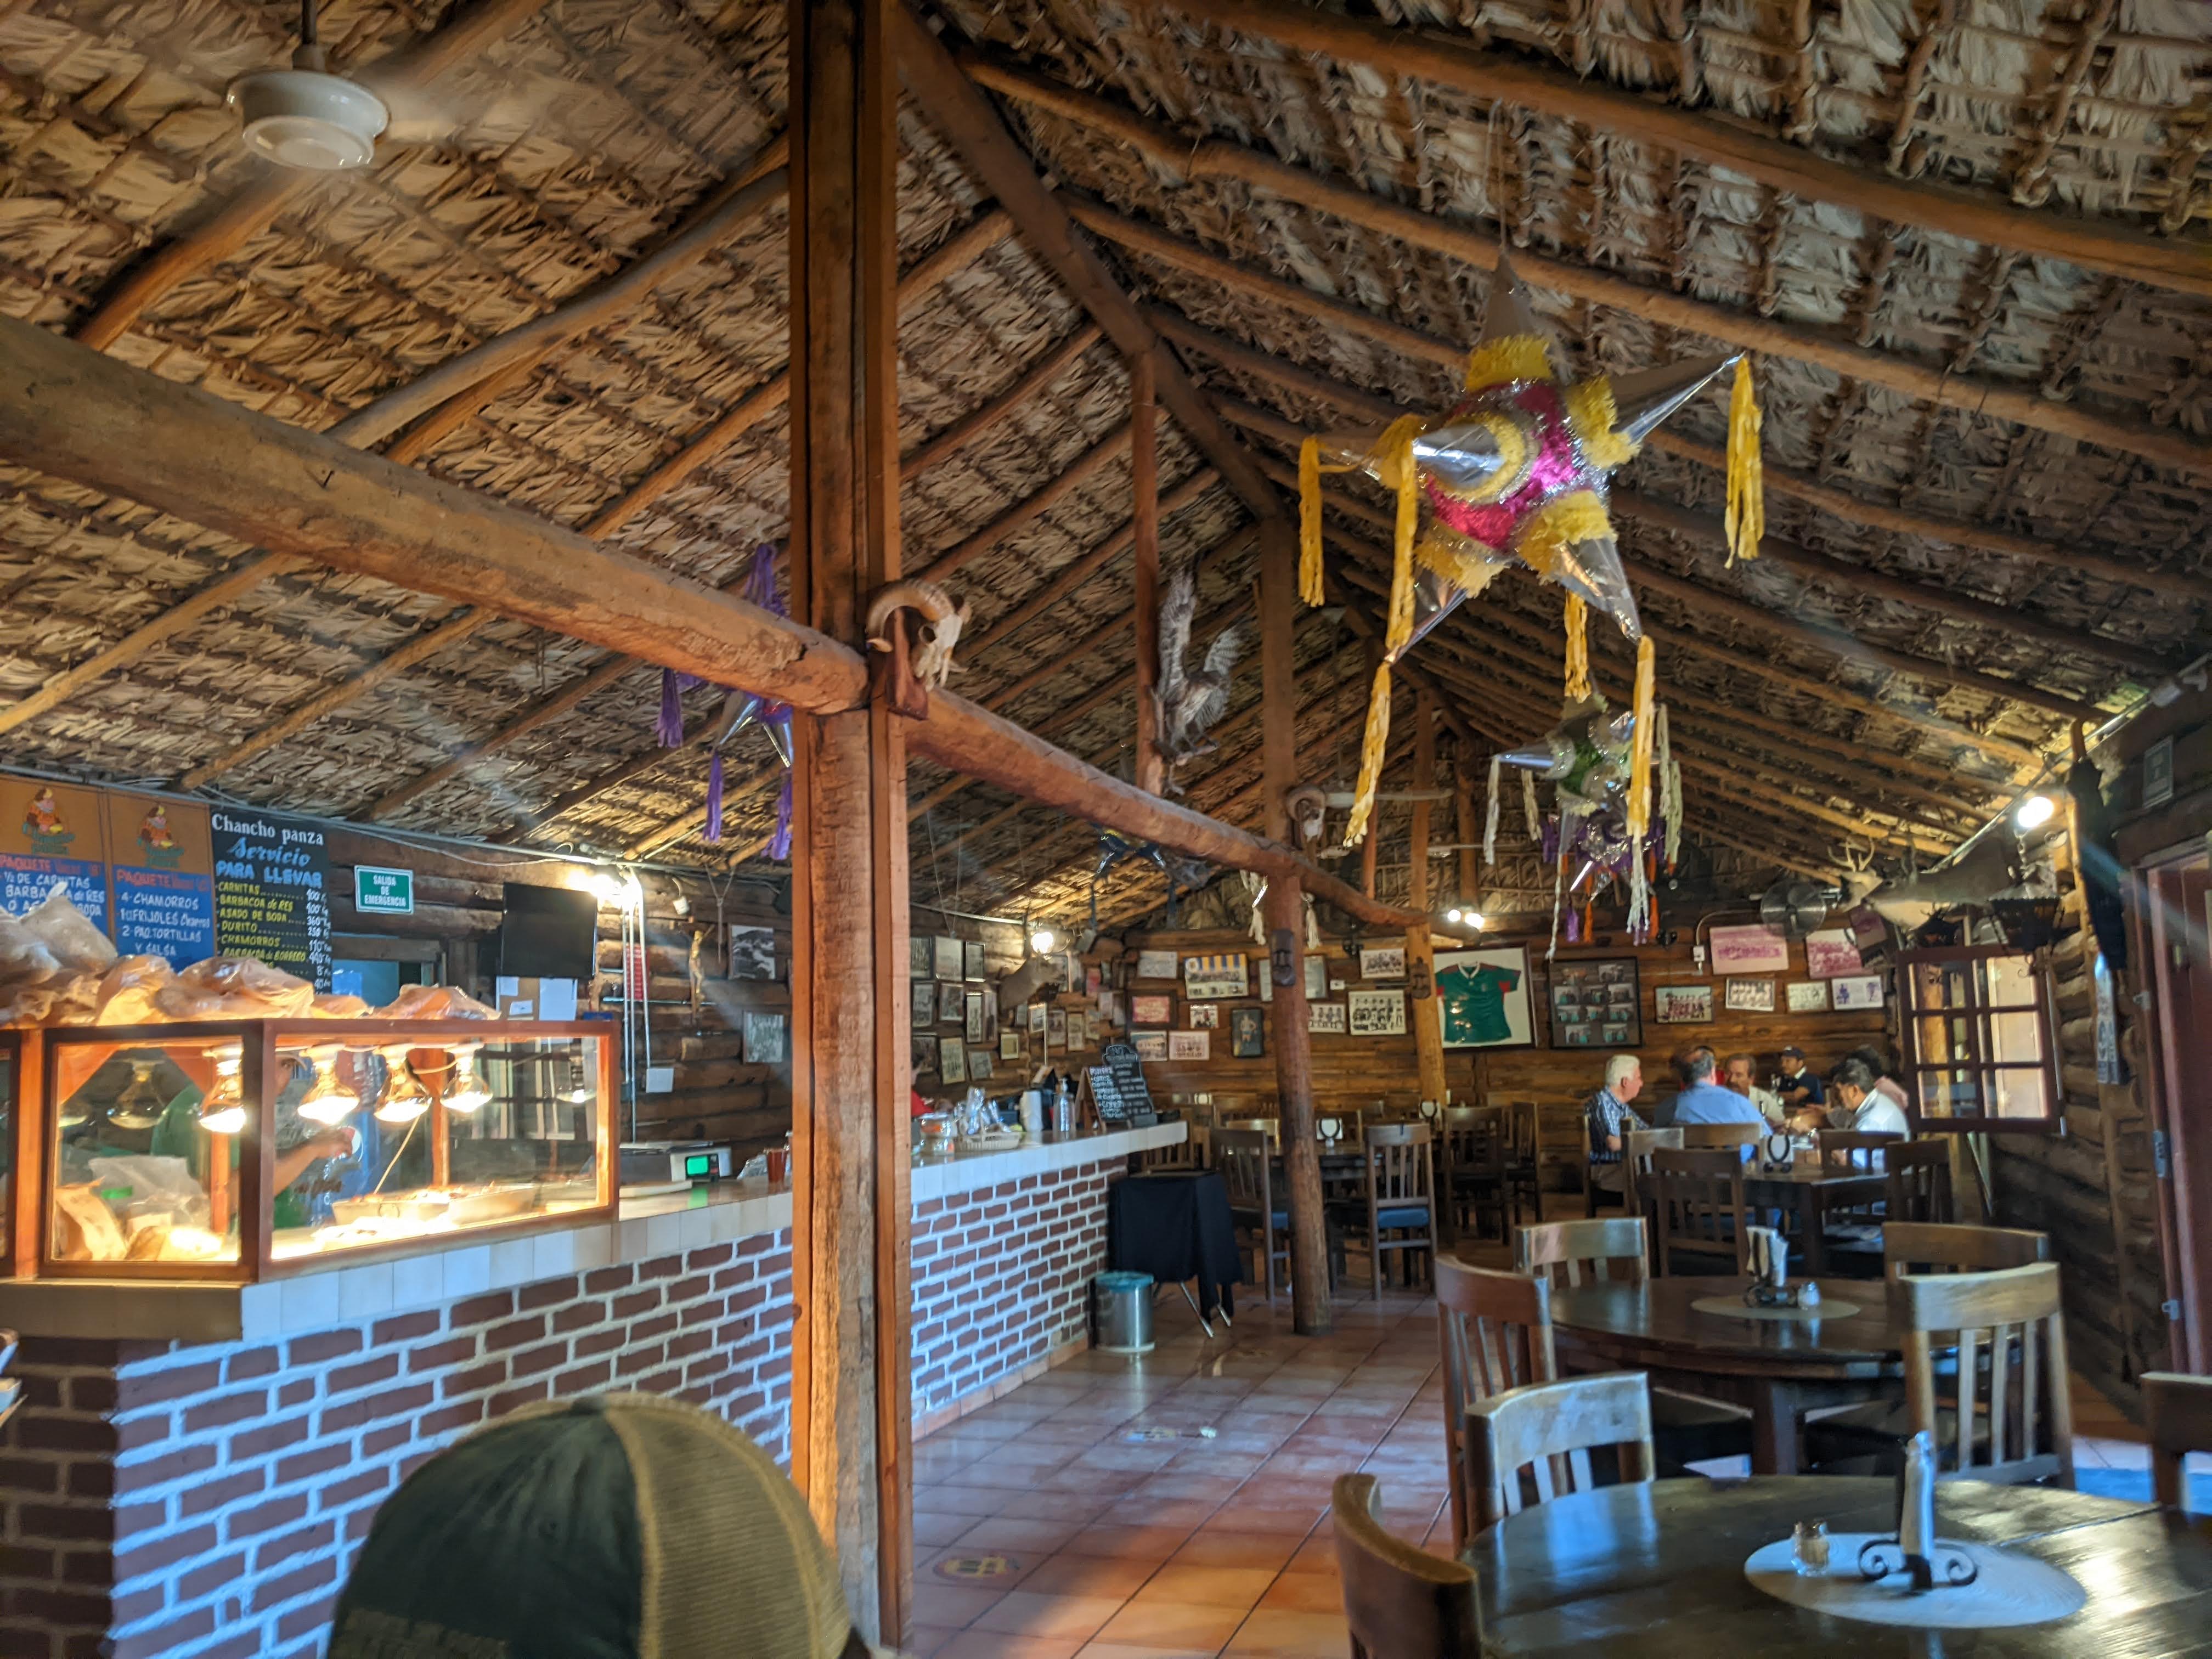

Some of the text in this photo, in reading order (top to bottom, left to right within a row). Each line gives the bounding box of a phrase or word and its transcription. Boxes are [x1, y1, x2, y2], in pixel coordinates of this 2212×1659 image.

[212, 813, 324, 845] Chancho panza
[228, 837, 311, 867] Servicio
[17, 872, 31, 885] DE
[216, 860, 323, 889] PARA LLEVAR
[373, 874, 396, 886] SALIDA
[218, 882, 261, 895] CARNITAS
[381, 885, 390, 896] DE
[133, 892, 199, 910] CHAMORROS
[220, 894, 266, 910] BARBACOA
[278, 900, 294, 913] RES
[364, 894, 407, 907] EMERGENCIA
[220, 907, 249, 919] ASADO
[252, 910, 263, 922] DE
[266, 911, 287, 923] BODA
[221, 934, 281, 947] CHAMORROS
[146, 943, 177, 957] SALSA
